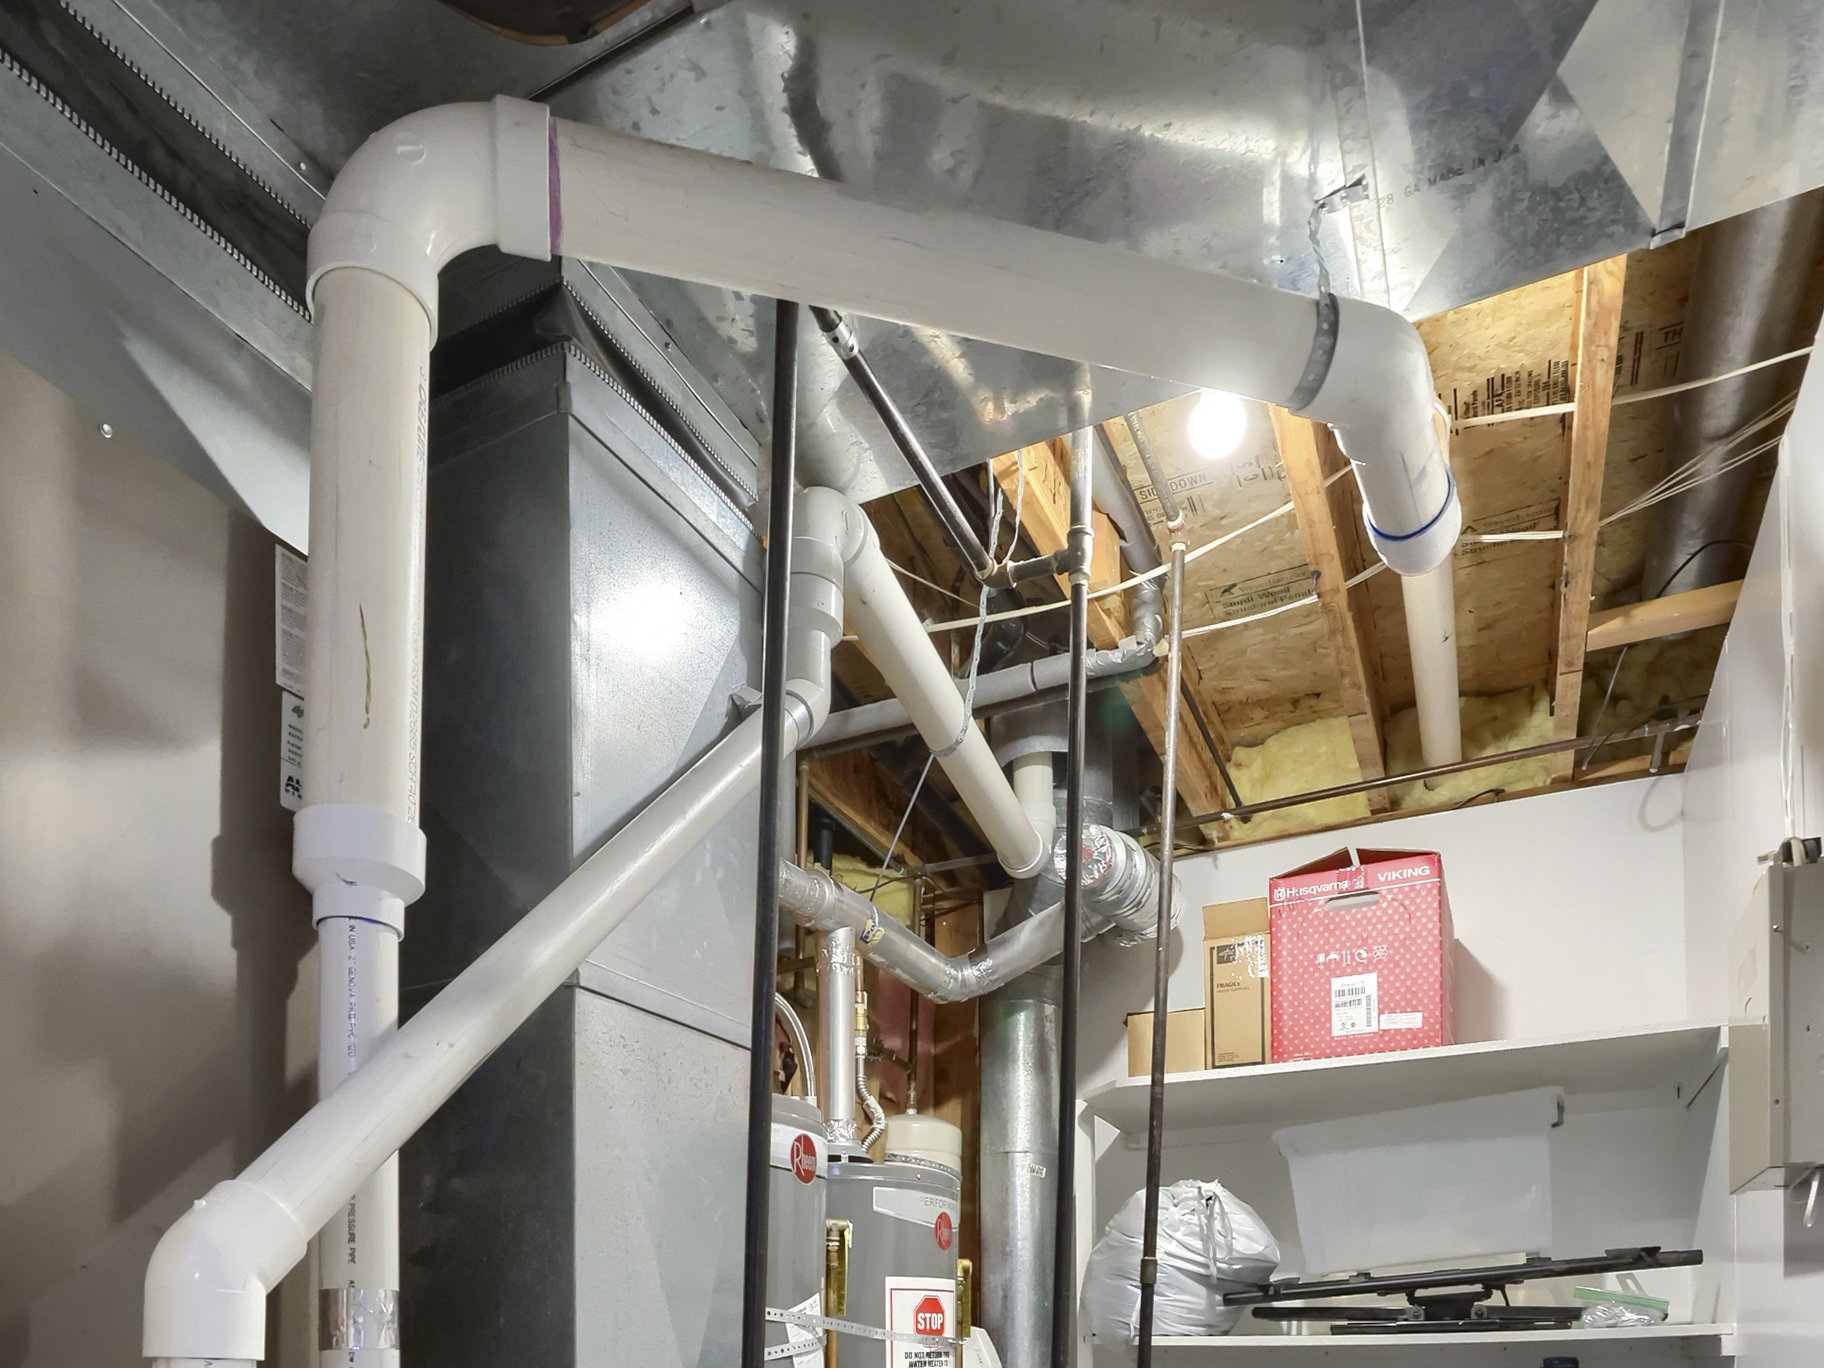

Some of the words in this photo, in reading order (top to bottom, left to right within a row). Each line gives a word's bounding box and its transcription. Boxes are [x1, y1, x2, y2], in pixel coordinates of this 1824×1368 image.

[1169, 472, 1208, 491] DOWN
[1286, 878, 1350, 898] Husqvarna
[1377, 865, 1431, 883] VIKING
[793, 1135, 817, 1176] Rheem
[347, 1202, 356, 1244] PRESSURE
[347, 1247, 356, 1265] PIPE
[917, 1312, 943, 1331] STOP
[904, 1351, 913, 1360] DO
[914, 1351, 925, 1360] NOT
[908, 1359, 927, 1368] WATER
